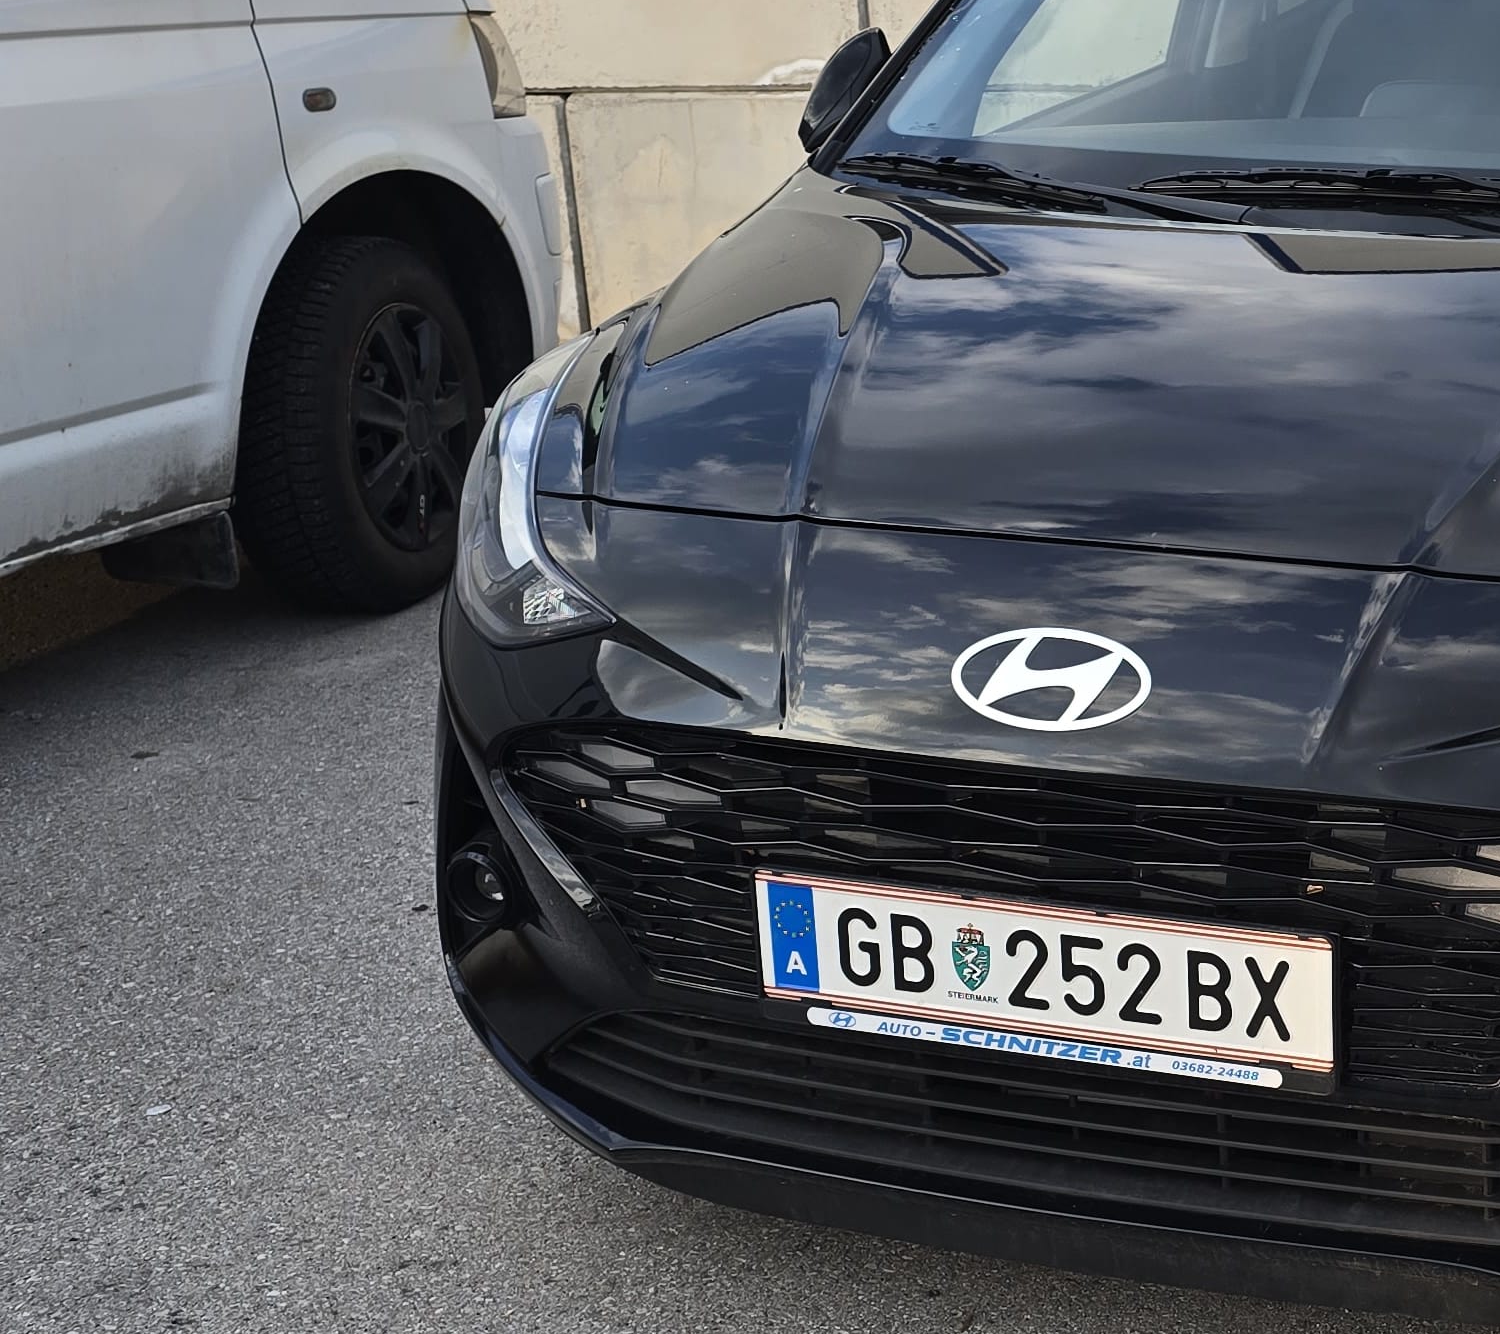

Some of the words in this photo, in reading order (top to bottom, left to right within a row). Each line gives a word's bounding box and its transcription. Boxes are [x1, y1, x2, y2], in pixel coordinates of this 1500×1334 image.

[785, 950, 808, 976] A
[837, 907, 936, 993] GB
[1005, 928, 1162, 1025] 252
[1187, 949, 1292, 1043] BX
[947, 990, 999, 1004] STEIERMARK
[876, 1021, 922, 1037] AUTO
[1171, 1059, 1261, 1082] 03682-24488
